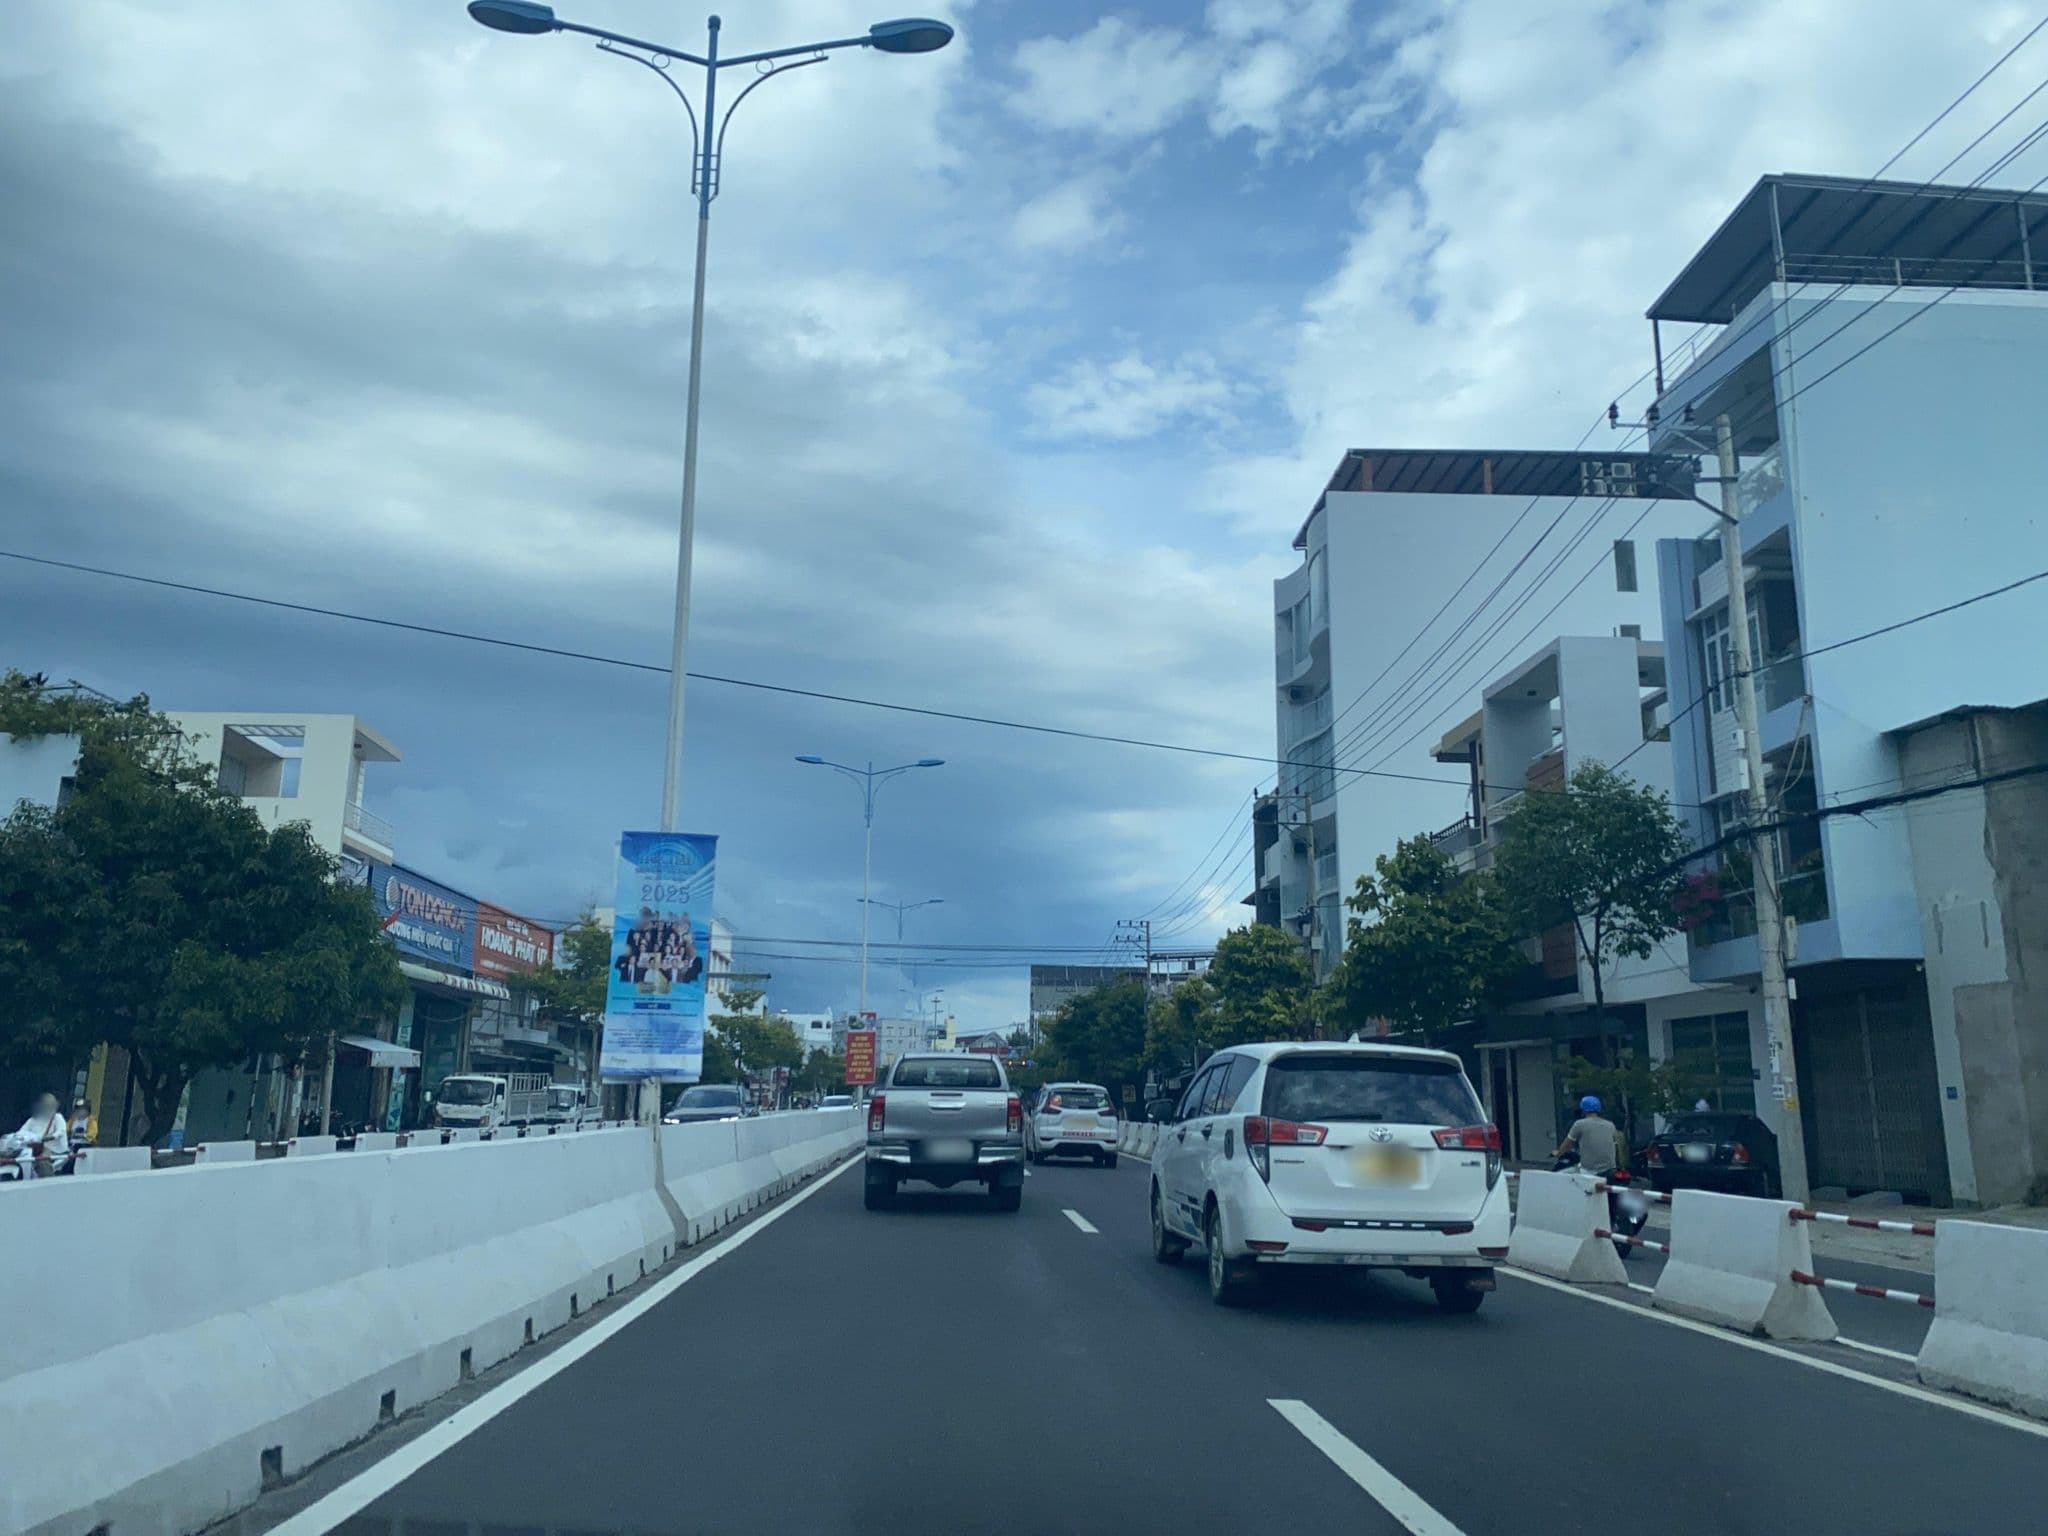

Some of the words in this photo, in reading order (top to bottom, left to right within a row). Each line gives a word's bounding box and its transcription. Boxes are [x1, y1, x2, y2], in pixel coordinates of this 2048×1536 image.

[641, 884, 690, 904] 2025
[426, 930, 443, 949] QUỐC
[442, 937, 453, 952] GIA
[481, 924, 513, 956] HOÀNG
[514, 937, 536, 963] PHÁT
